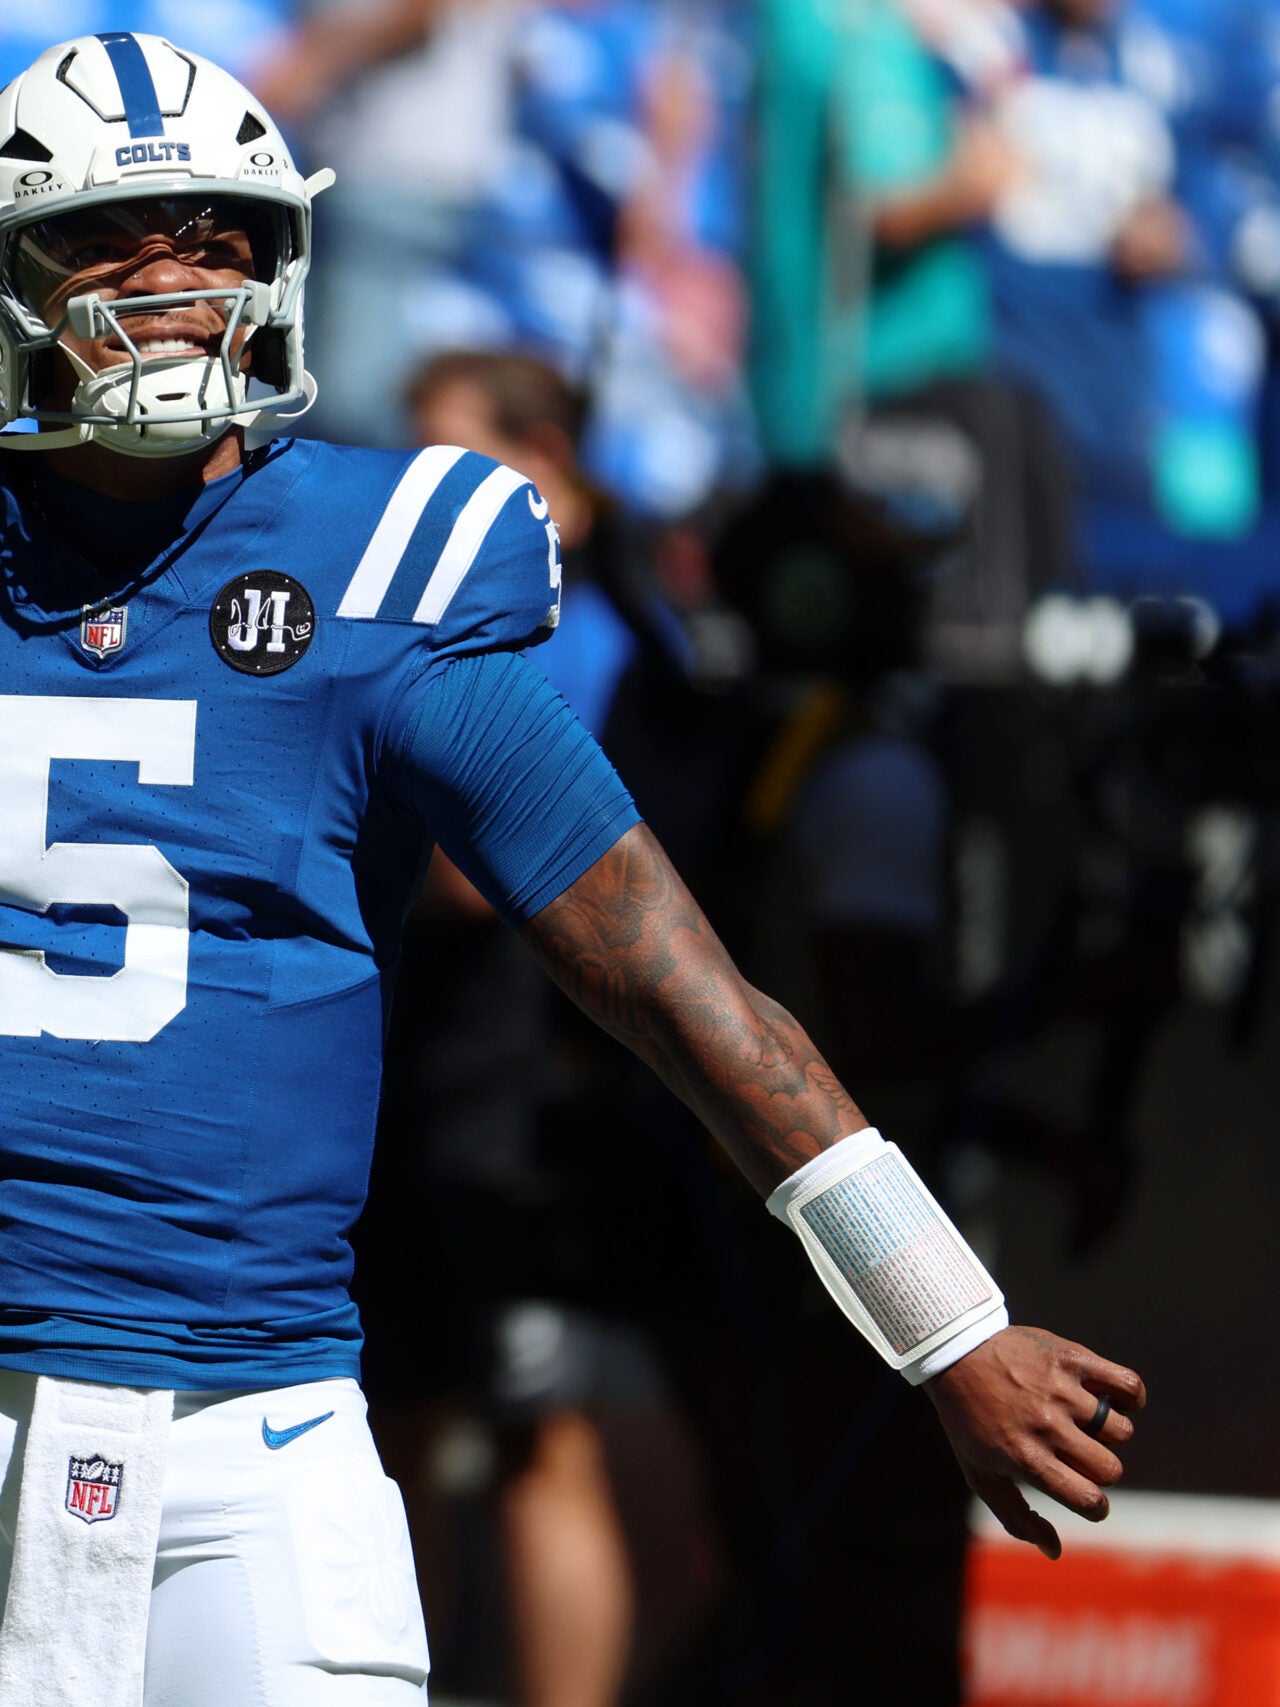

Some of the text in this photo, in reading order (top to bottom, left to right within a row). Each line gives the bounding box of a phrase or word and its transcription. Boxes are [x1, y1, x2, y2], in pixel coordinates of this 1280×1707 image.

[115, 142, 192, 167] COLTS
[243, 168, 280, 177] OAKLEY
[14, 183, 63, 199] OAKLEY
[87, 625, 118, 648] NFL
[70, 1481, 113, 1516] NFL
